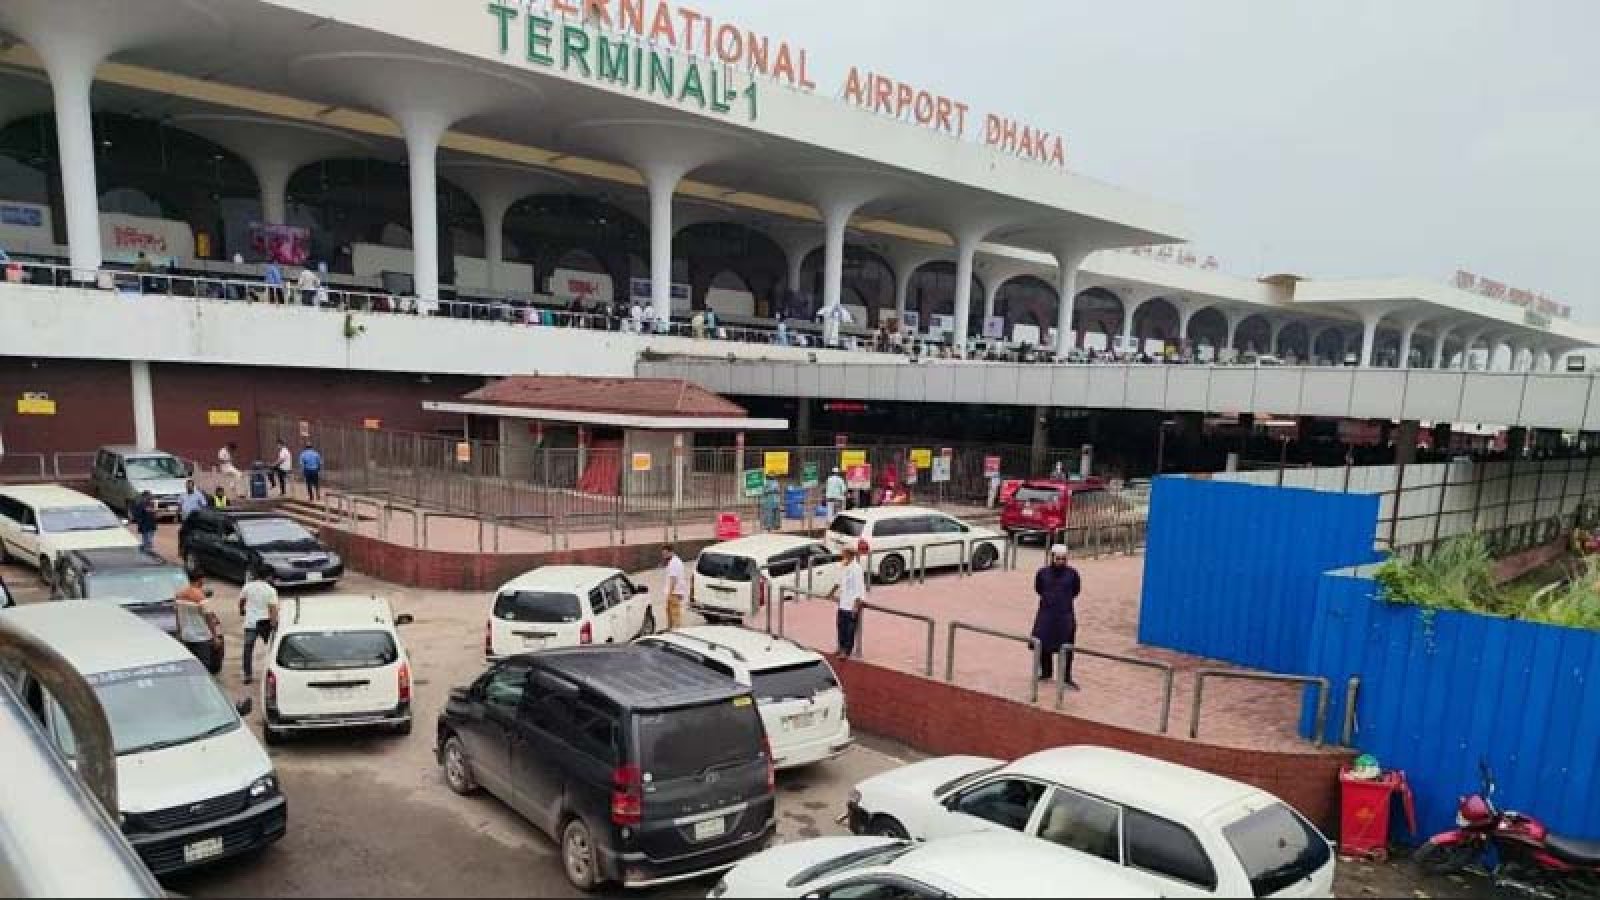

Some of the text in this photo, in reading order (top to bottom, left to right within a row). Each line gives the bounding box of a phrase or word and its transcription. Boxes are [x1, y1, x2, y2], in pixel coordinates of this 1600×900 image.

[487, 3, 760, 121] TERMINAL-1
[843, 65, 969, 136] AIRPORT
[985, 113, 1066, 166] DHAKA
